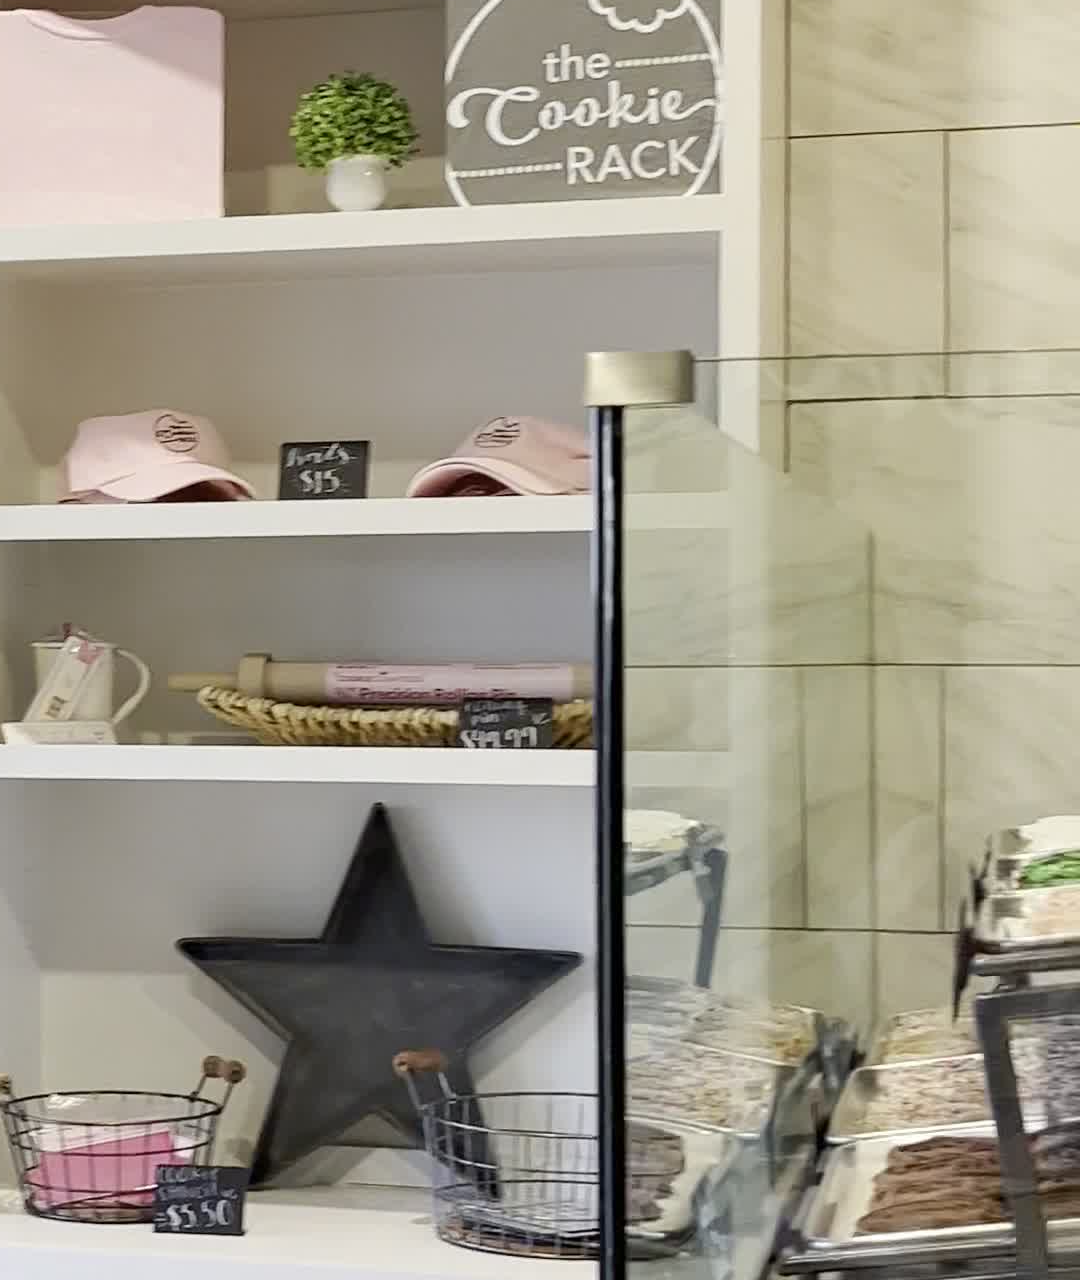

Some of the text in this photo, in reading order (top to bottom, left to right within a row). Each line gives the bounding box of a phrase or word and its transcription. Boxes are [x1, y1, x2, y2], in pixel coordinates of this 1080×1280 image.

[541, 43, 612, 83] the
[446, 79, 717, 146] Cookie
[566, 135, 702, 185] RACK
[299, 468, 341, 495] $15
